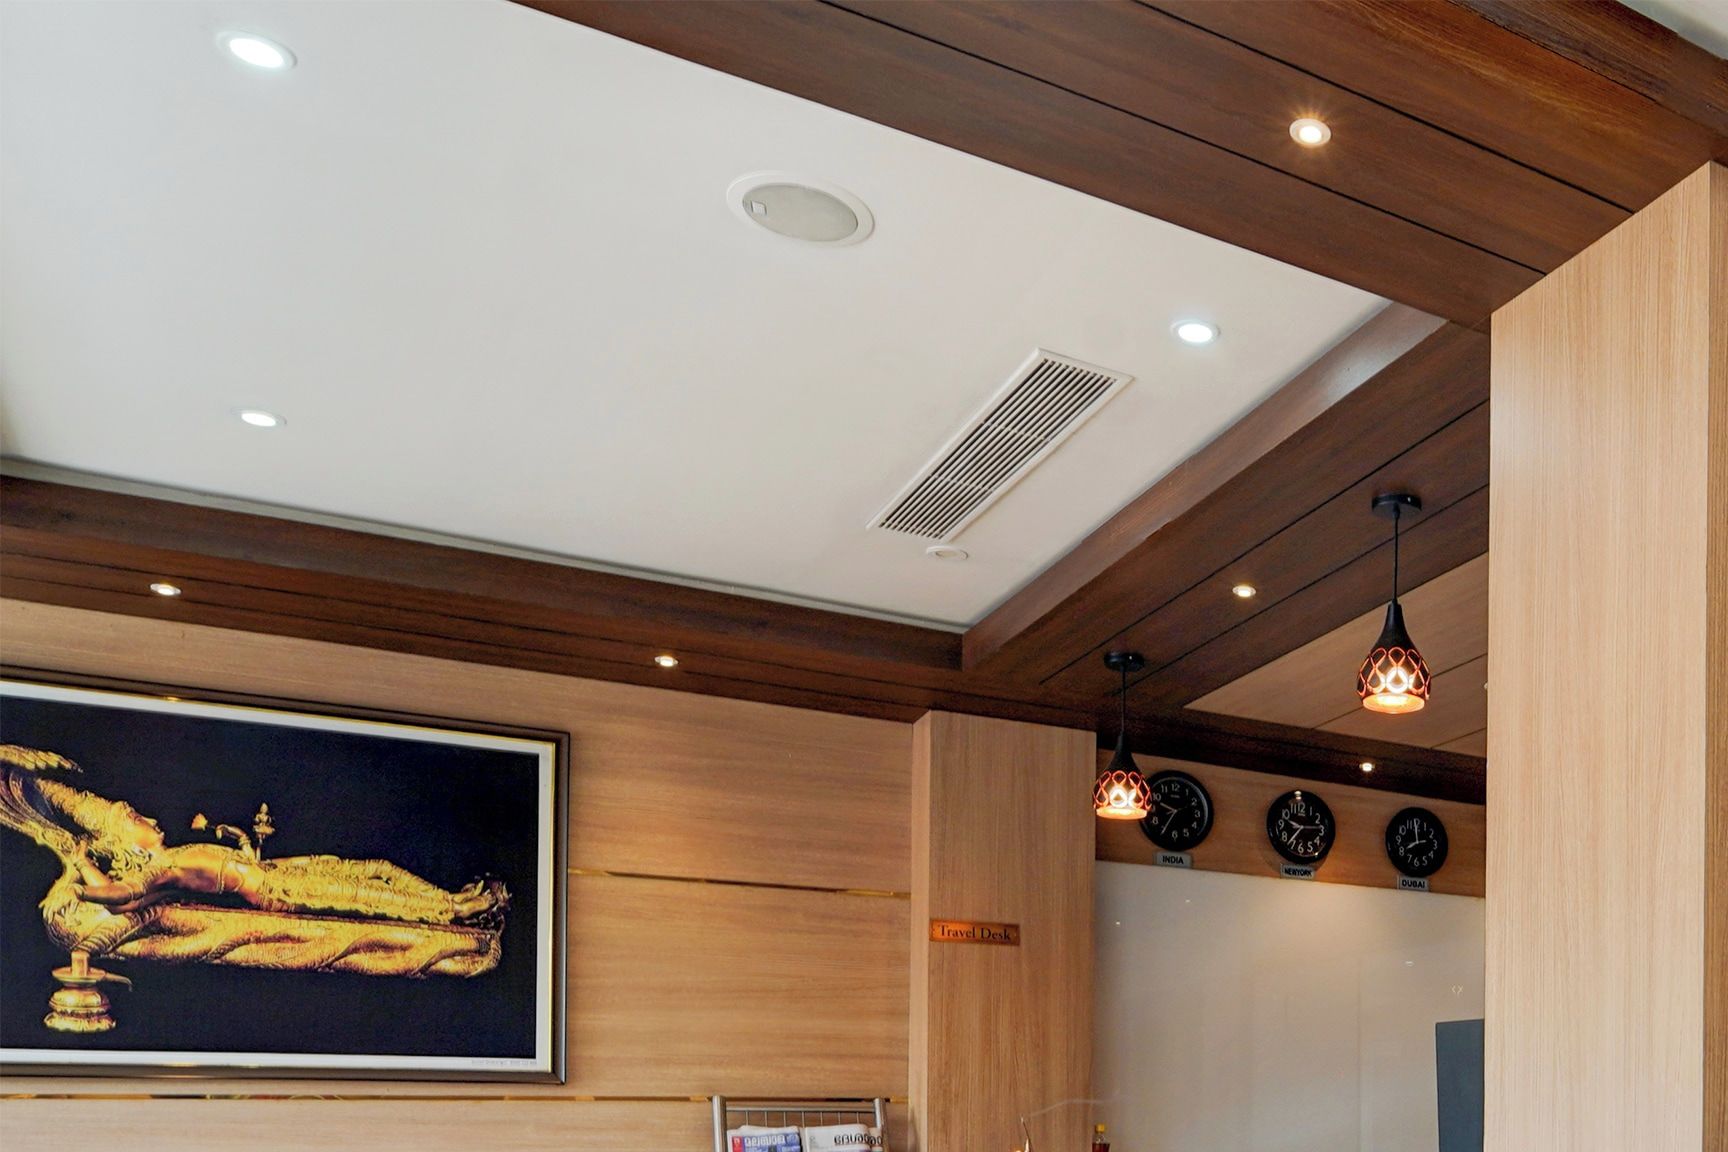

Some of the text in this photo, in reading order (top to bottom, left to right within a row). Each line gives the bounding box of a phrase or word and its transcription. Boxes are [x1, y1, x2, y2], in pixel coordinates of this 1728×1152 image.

[1161, 784, 1168, 793] 11
[1171, 783, 1180, 792] 12
[1153, 793, 1161, 801] 10
[1290, 803, 1297, 814] 11
[1298, 802, 1306, 813] 12
[1282, 809, 1290, 820] 10
[1315, 813, 1321, 824] 2
[1278, 819, 1285, 830] 9
[1399, 825, 1407, 835] 10
[1406, 819, 1413, 830] 11
[1319, 825, 1325, 836] 3
[1282, 831, 1288, 842] 8
[1314, 836, 1320, 846] 4
[1297, 842, 1304, 854] 6
[1307, 841, 1313, 852] 5
[1162, 855, 1184, 865] INDIA
[1401, 879, 1426, 889] DUBAI
[938, 924, 1011, 941] Travel Desk
